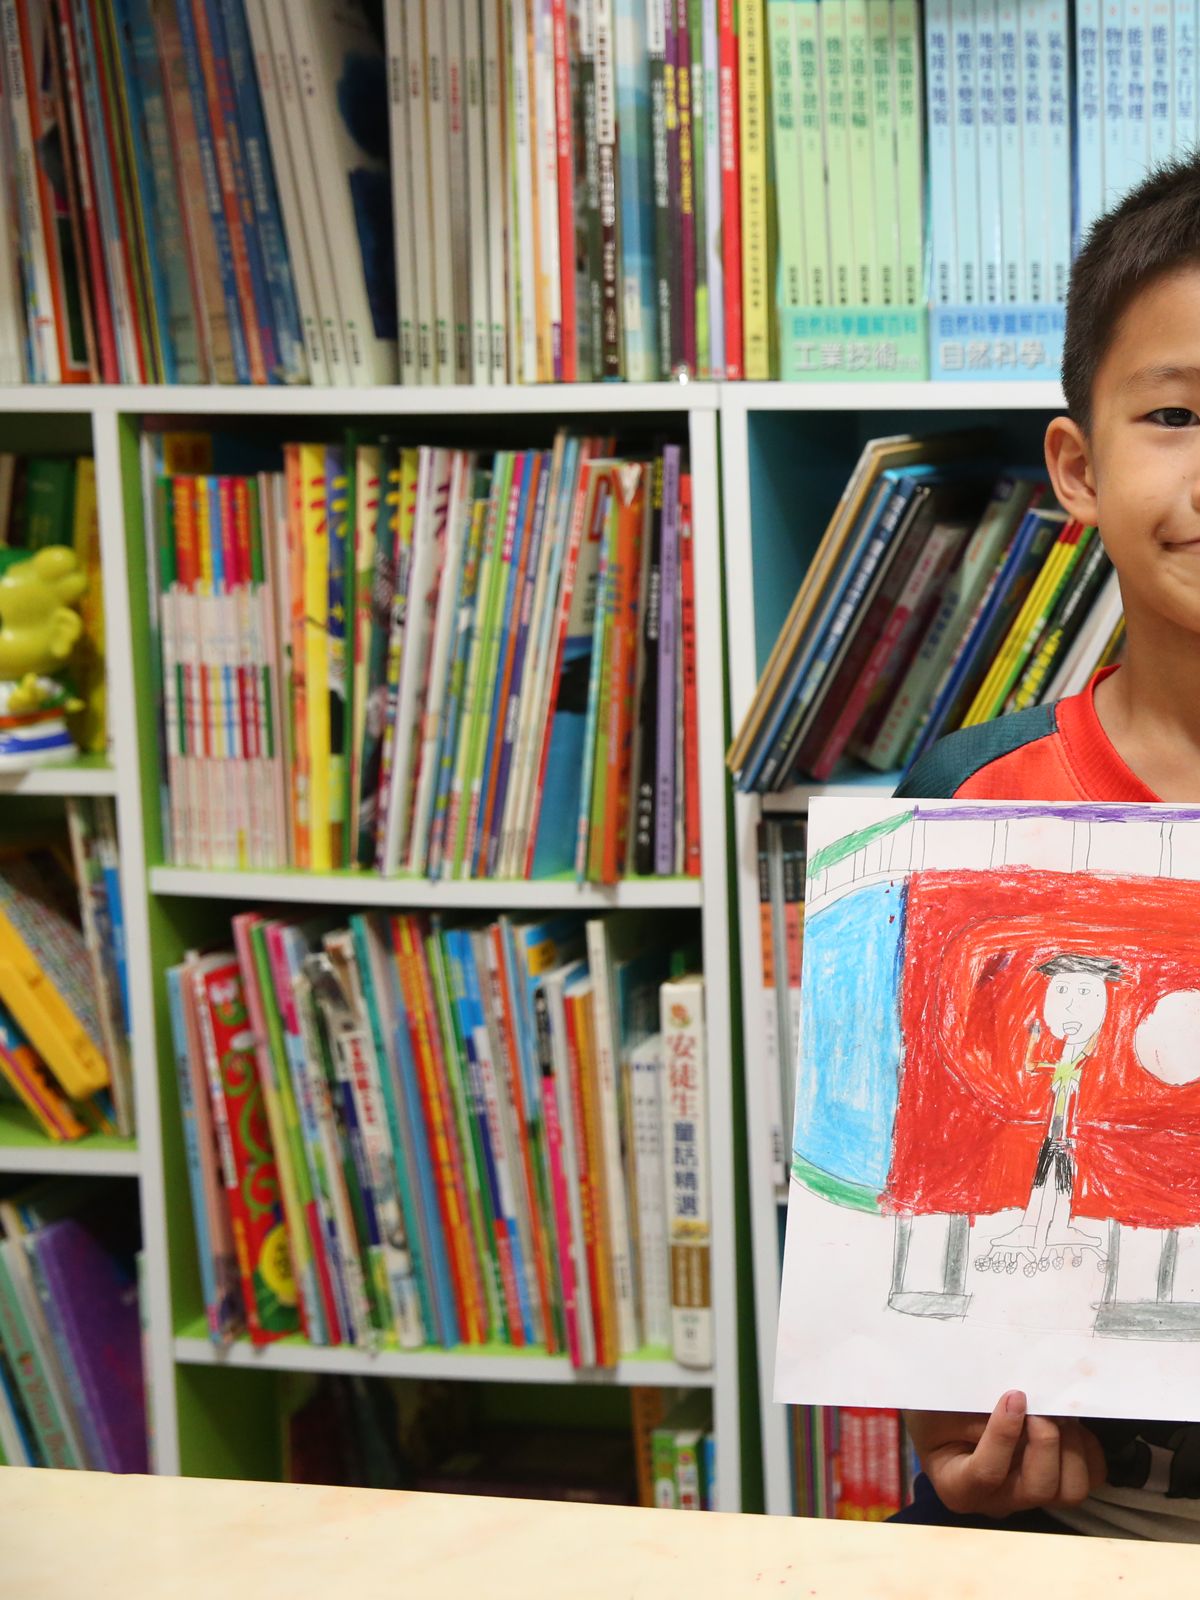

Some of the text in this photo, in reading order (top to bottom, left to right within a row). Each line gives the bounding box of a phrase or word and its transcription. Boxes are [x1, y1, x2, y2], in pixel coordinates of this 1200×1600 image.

[794, 340, 899, 372] 工業技術
[940, 338, 1046, 371] 自然科學
[667, 1033, 698, 1217] 安徒生童話精選
